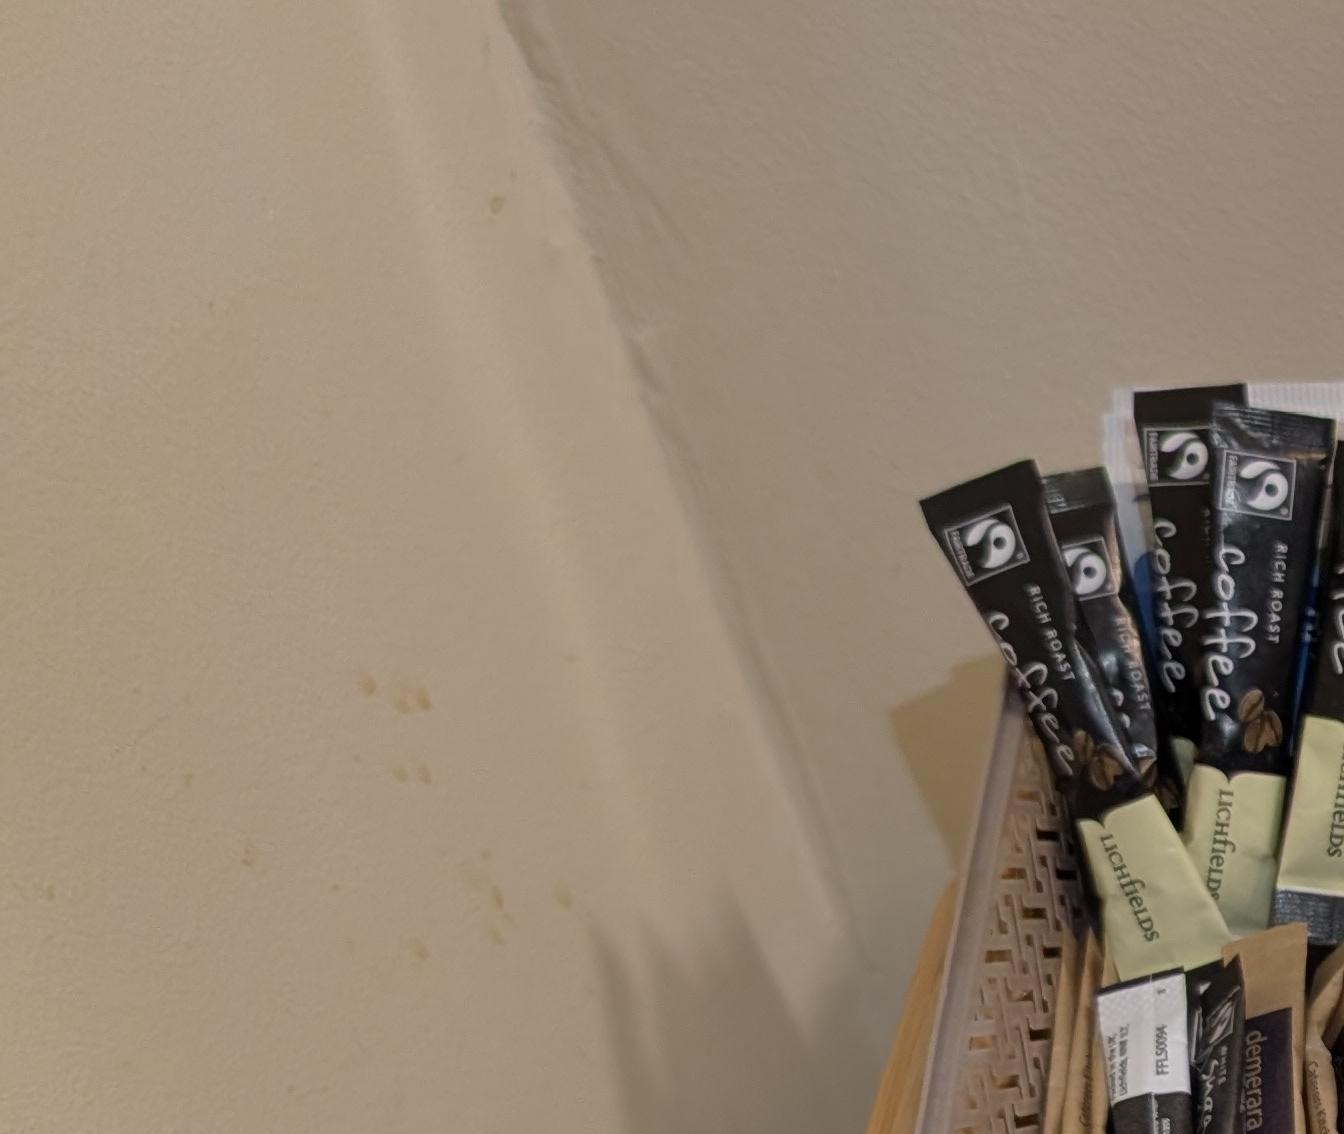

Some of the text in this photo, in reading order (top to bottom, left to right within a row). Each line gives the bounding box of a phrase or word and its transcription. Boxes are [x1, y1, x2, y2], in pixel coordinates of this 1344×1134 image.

[1027, 583, 1076, 682] RICH ROAST
[1155, 518, 1199, 693] coffee
[1202, 547, 1259, 721] coffee
[1266, 540, 1288, 645] RICH ROAST
[988, 611, 1075, 777] coffee
[1245, 1030, 1267, 1131] demerara
